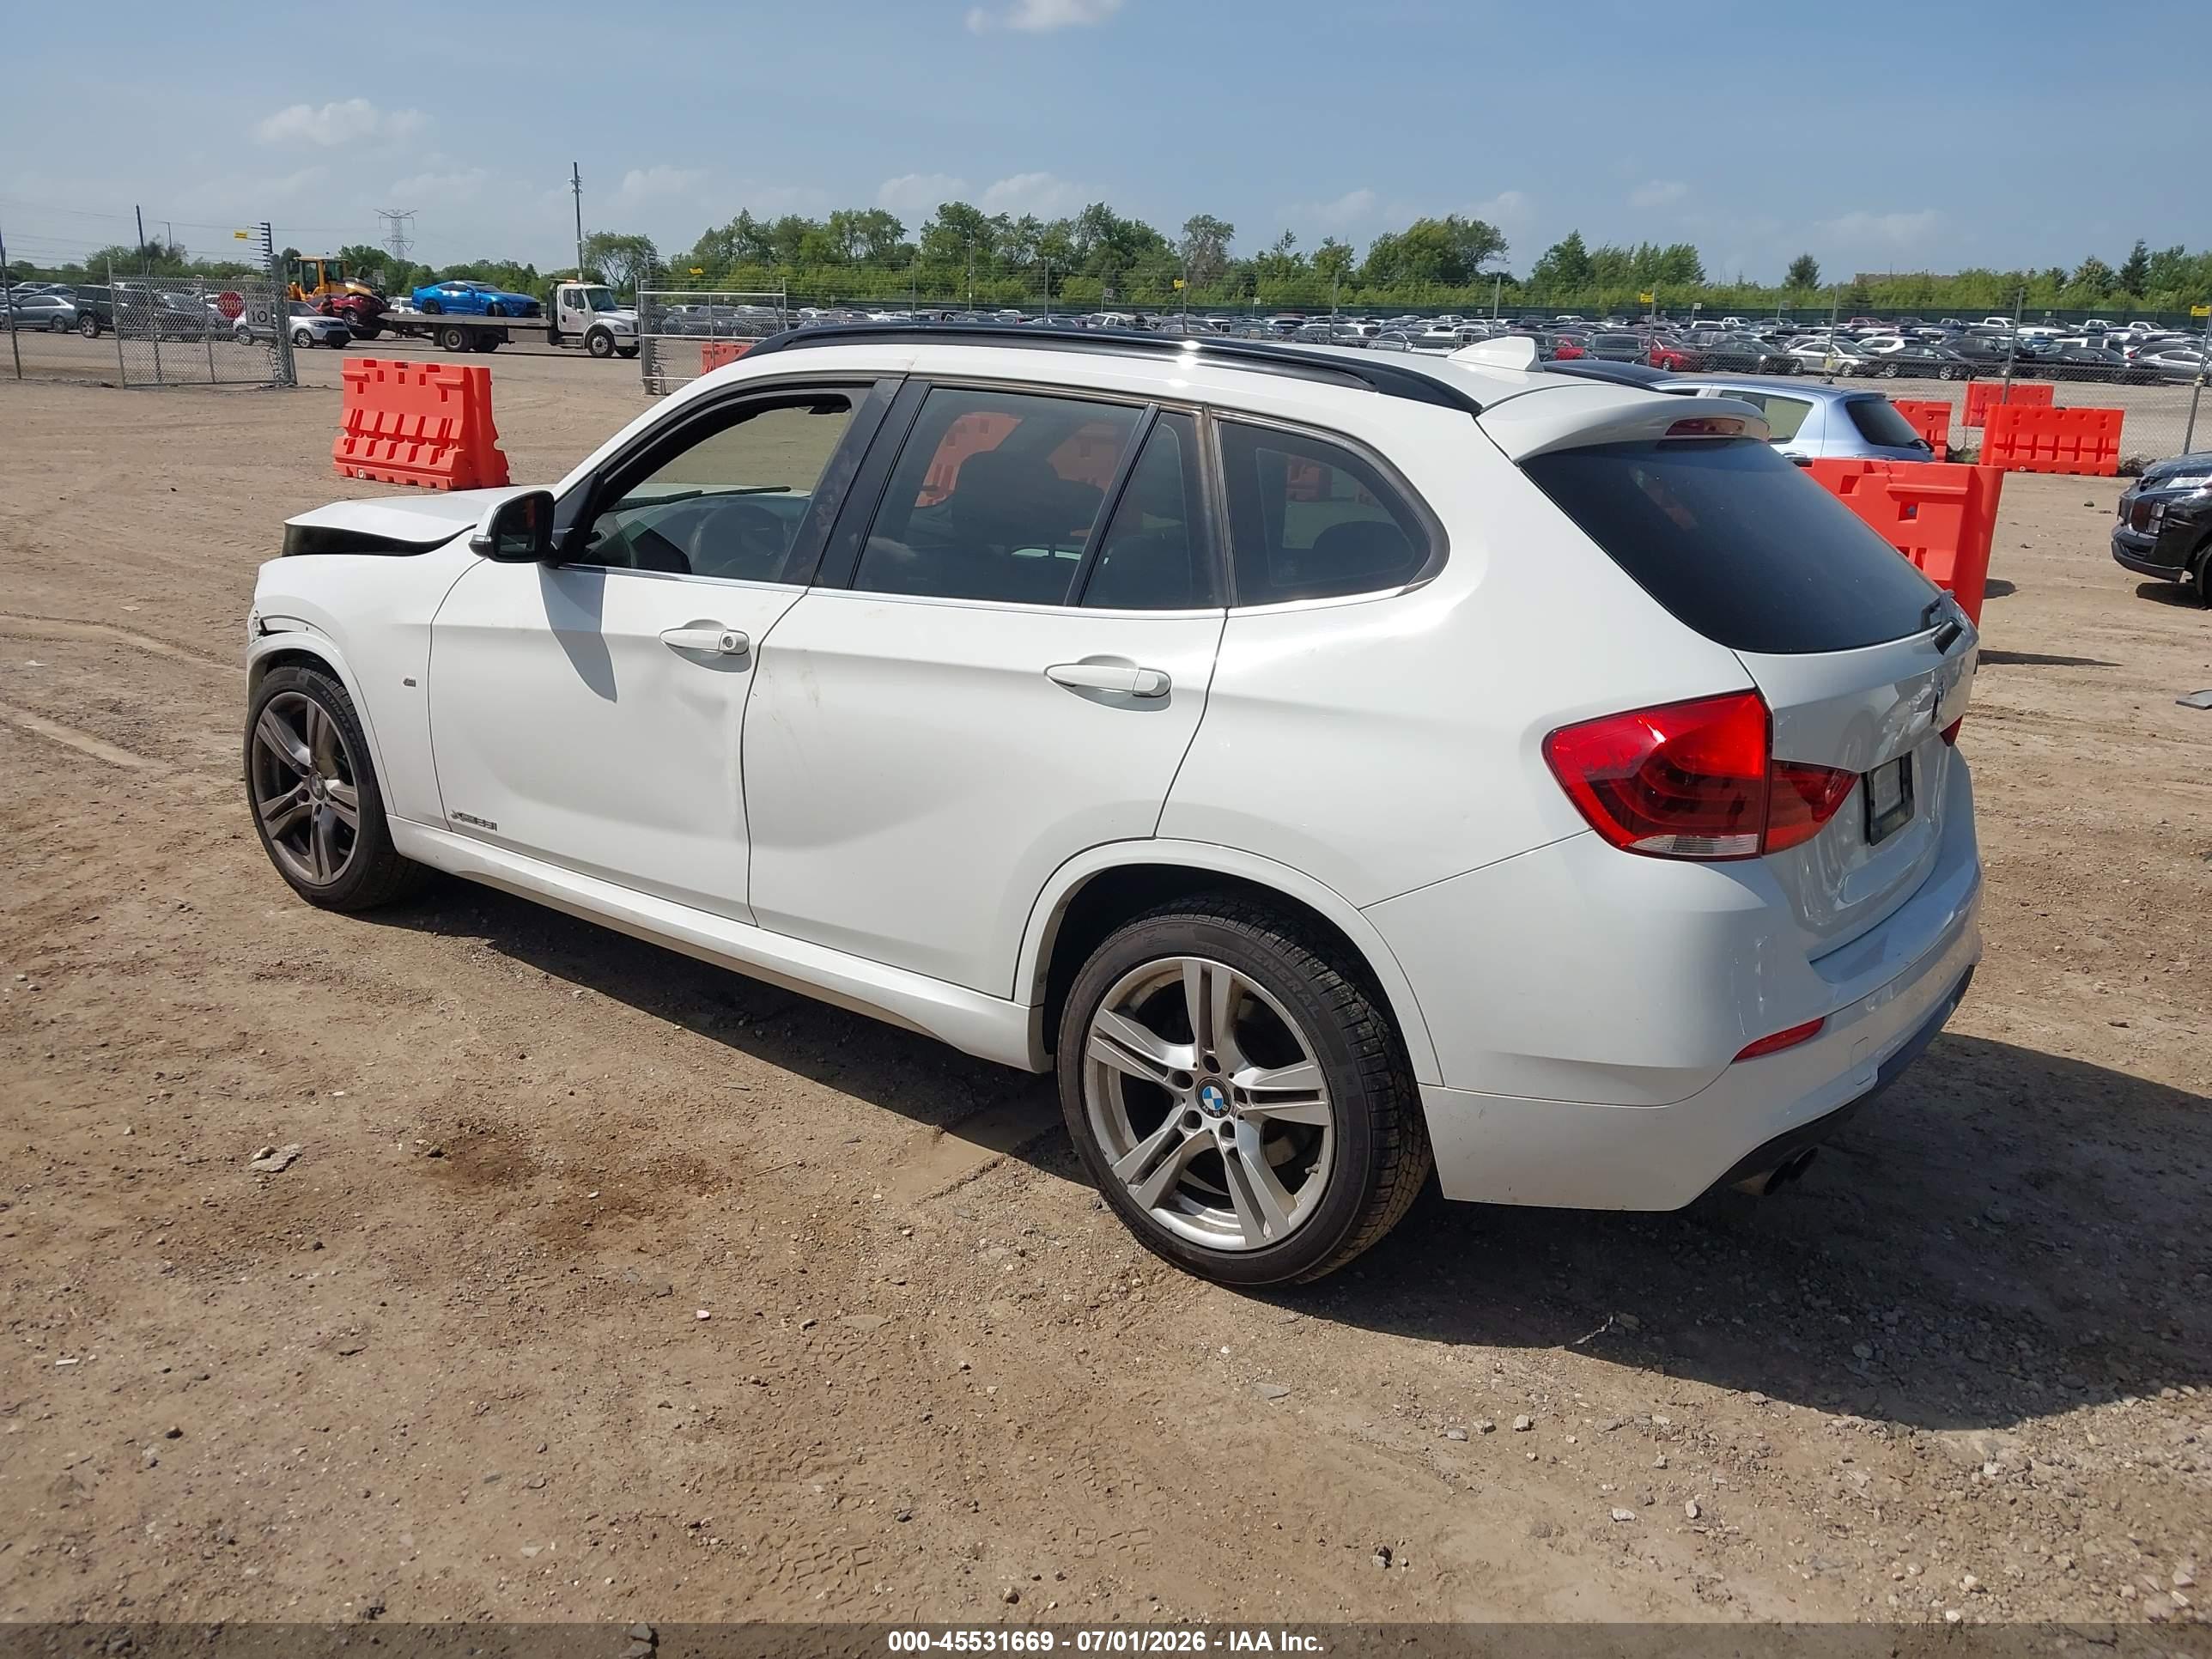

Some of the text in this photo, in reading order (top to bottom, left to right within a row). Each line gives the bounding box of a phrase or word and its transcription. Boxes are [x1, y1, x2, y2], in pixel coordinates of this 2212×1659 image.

[252, 310, 268, 323] 10
[1240, 945, 1320, 1019] GENERAL
[1201, 1103, 1229, 1117] BMW
